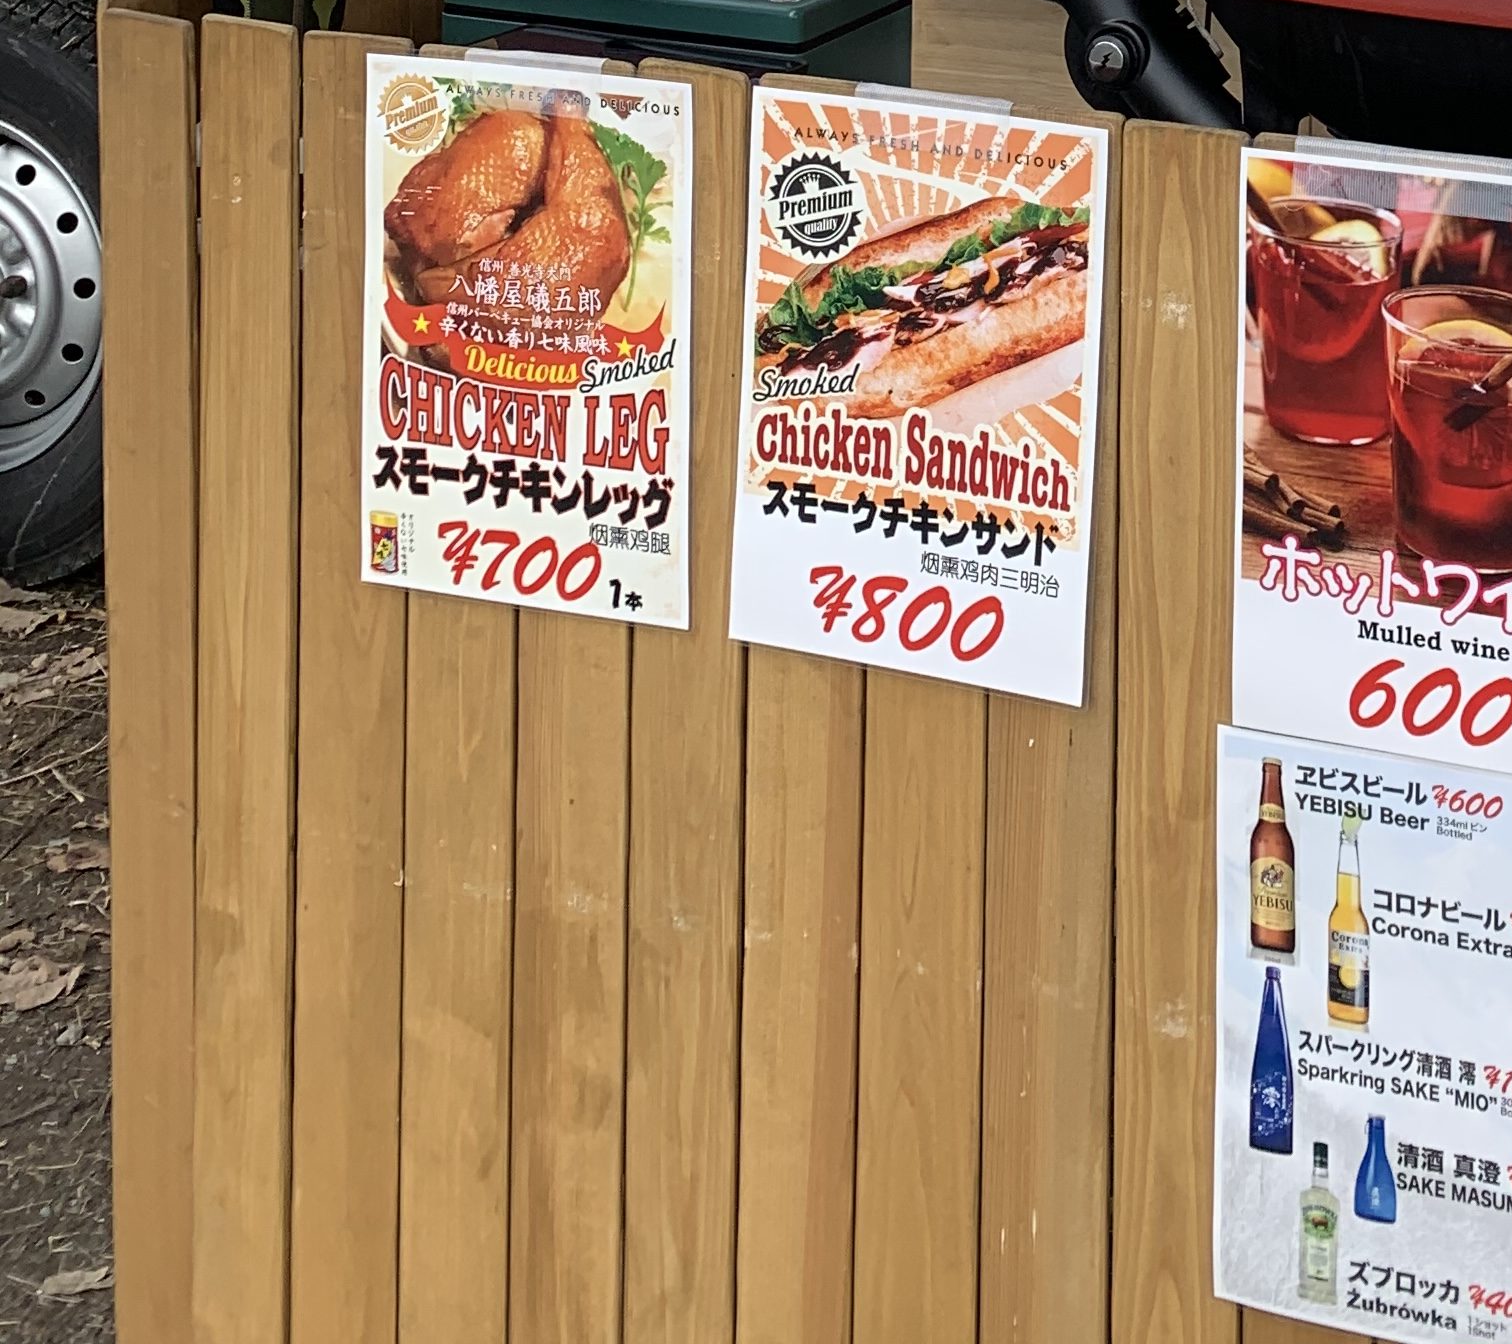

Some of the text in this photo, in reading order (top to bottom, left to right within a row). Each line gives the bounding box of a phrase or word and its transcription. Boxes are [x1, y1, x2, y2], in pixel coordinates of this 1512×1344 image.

[446, 83, 680, 116] ALWAYS FRESH AND DELICIOUS
[794, 126, 1068, 172] ALWAYS FRESH AND DELICIOUS
[778, 188, 854, 221] Premium
[803, 218, 838, 236] quality
[464, 339, 677, 393] Delicious Smoked
[752, 364, 860, 402] Smoked
[379, 357, 669, 475] CHICKEN LEG
[756, 408, 1071, 511] Chicken Sandwich
[372, 444, 675, 531] スモークチキンレッグ
[762, 480, 1060, 567] スモークチキンサンド
[809, 565, 1004, 662] ¥800
[1357, 619, 1442, 652] Mulled
[1450, 639, 1511, 663] wine
[1294, 792, 1430, 832] YEBISU Beer
[1252, 894, 1294, 912] YEBISU
[1371, 916, 1450, 947] Corona
[1396, 1172, 1446, 1200] SAKE
